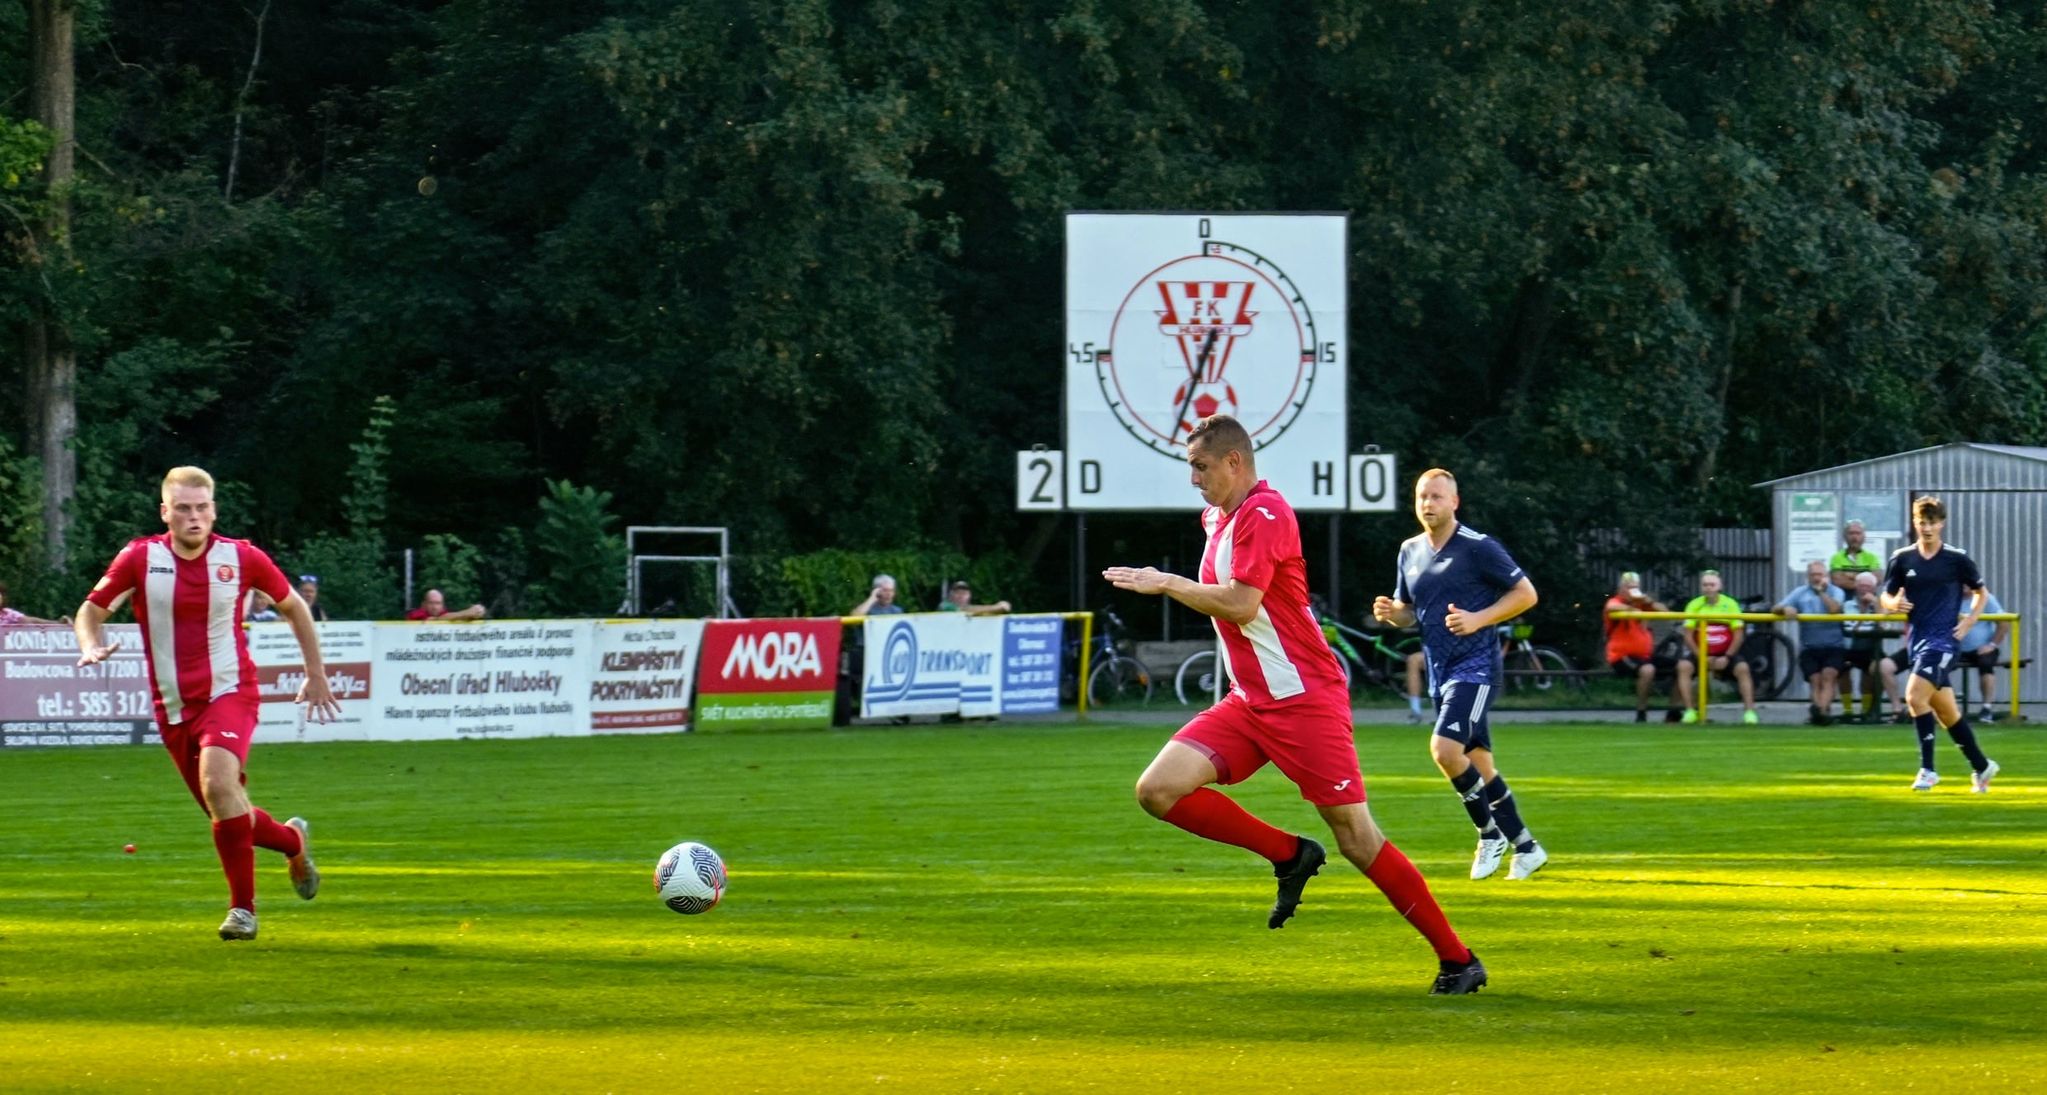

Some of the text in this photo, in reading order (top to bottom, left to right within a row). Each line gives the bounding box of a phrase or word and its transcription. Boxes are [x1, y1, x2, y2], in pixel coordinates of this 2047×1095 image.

[1193, 300, 1220, 316] FK
[1070, 342, 1094, 363] 45
[1319, 342, 1336, 363] 15
[1028, 457, 1053, 503] 2
[1080, 460, 1101, 494] D
[1312, 461, 1334, 496] H
[1359, 458, 1386, 503] 0
[600, 644, 687, 672] KLEMPÍŘSTVÍ
[721, 632, 823, 681] MORA
[920, 649, 993, 676] TRANSPORT
[401, 668, 562, 696] Obecní úřad Hlubočky
[590, 674, 685, 701] POKRÝVAČSTVÍ
[37, 690, 149, 717] tel.: 585 312
